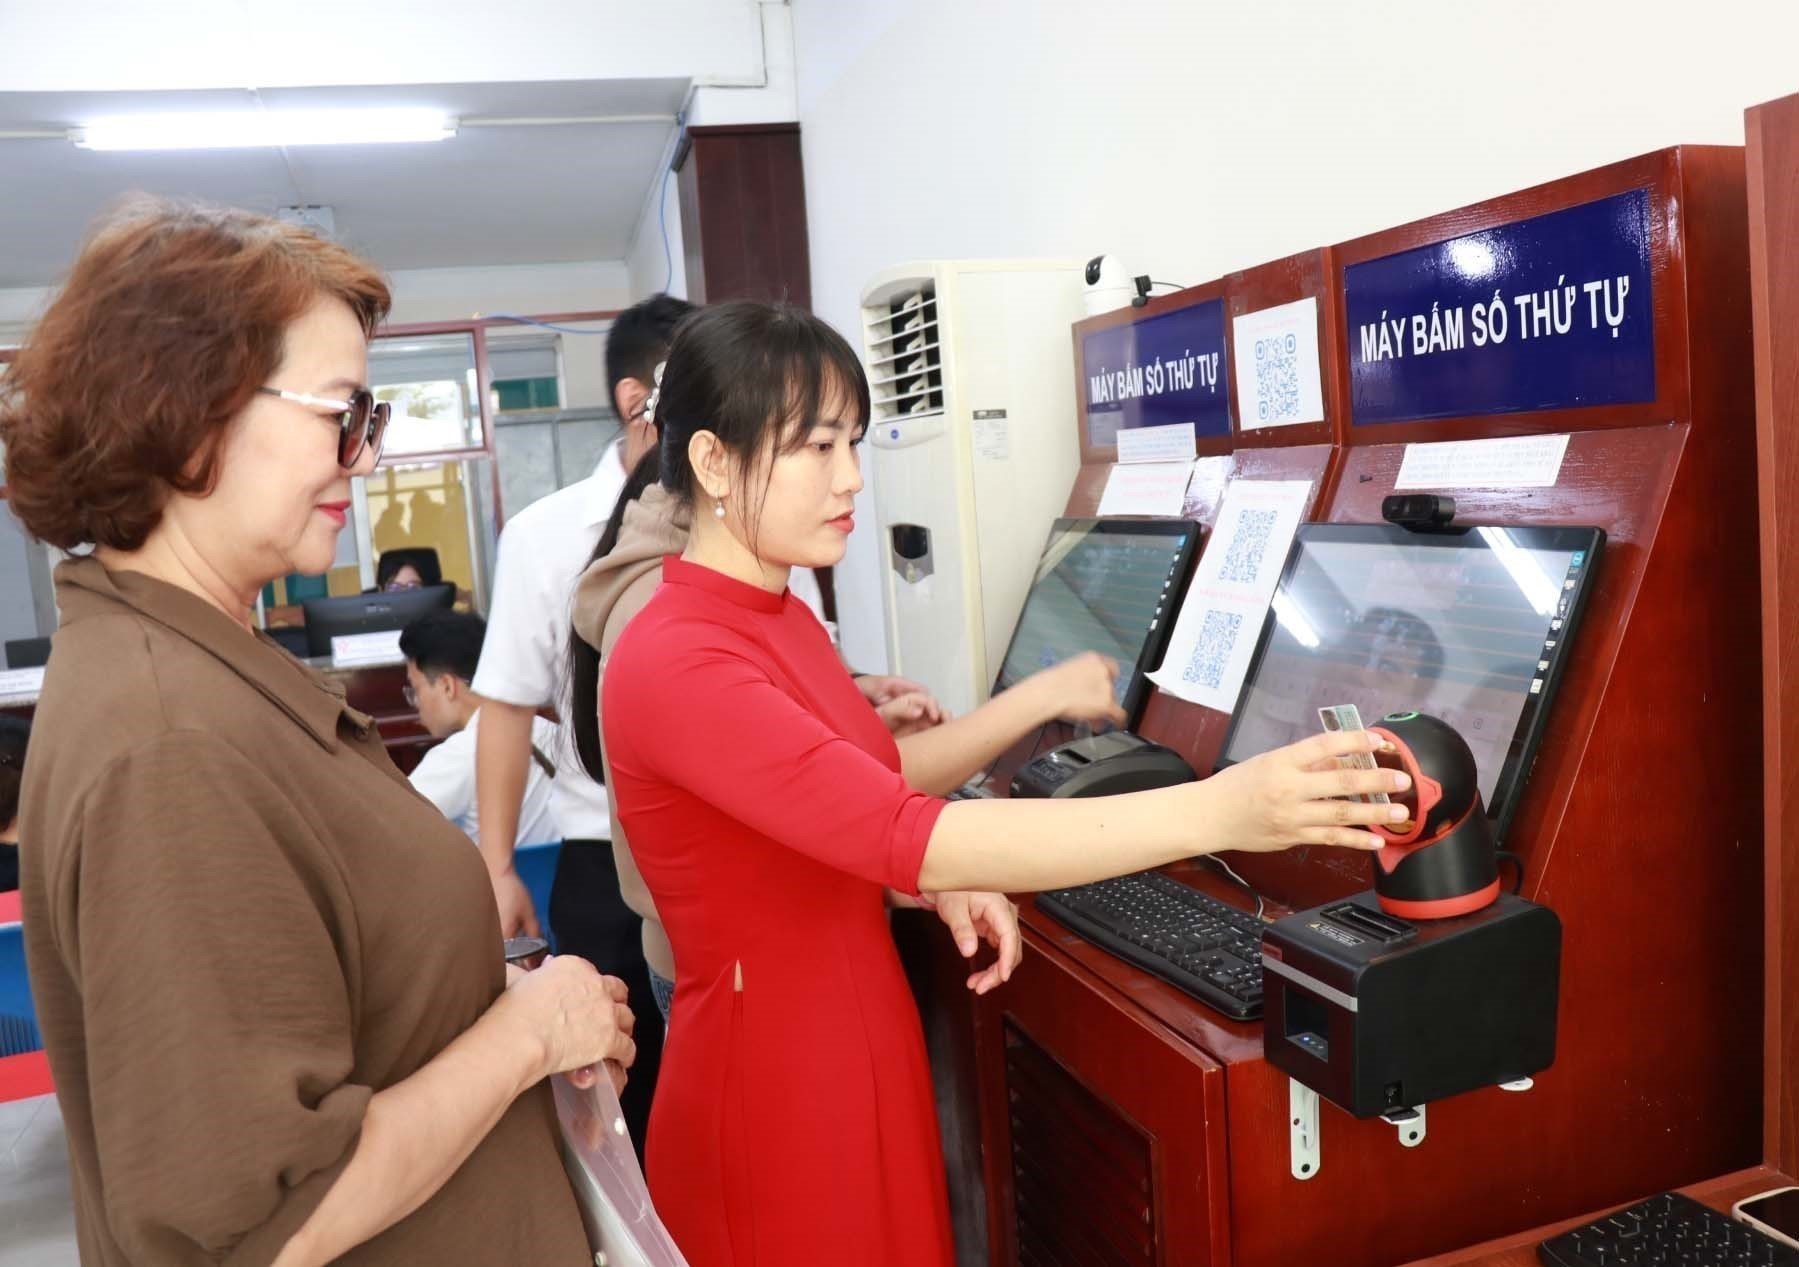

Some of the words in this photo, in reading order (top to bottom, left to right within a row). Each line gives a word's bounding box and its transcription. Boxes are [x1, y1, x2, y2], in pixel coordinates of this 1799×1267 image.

[1360, 310, 1406, 363] MÁY
[1412, 301, 1465, 356] BẤM
[1471, 289, 1508, 347] SỐ
[1514, 274, 1577, 340] THỨ
[1583, 275, 1630, 338] TỰ
[1090, 367, 1116, 404] MÁY
[1145, 355, 1165, 396] SỐ
[1165, 348, 1196, 392] THỨ
[1197, 351, 1220, 394] TỰ
